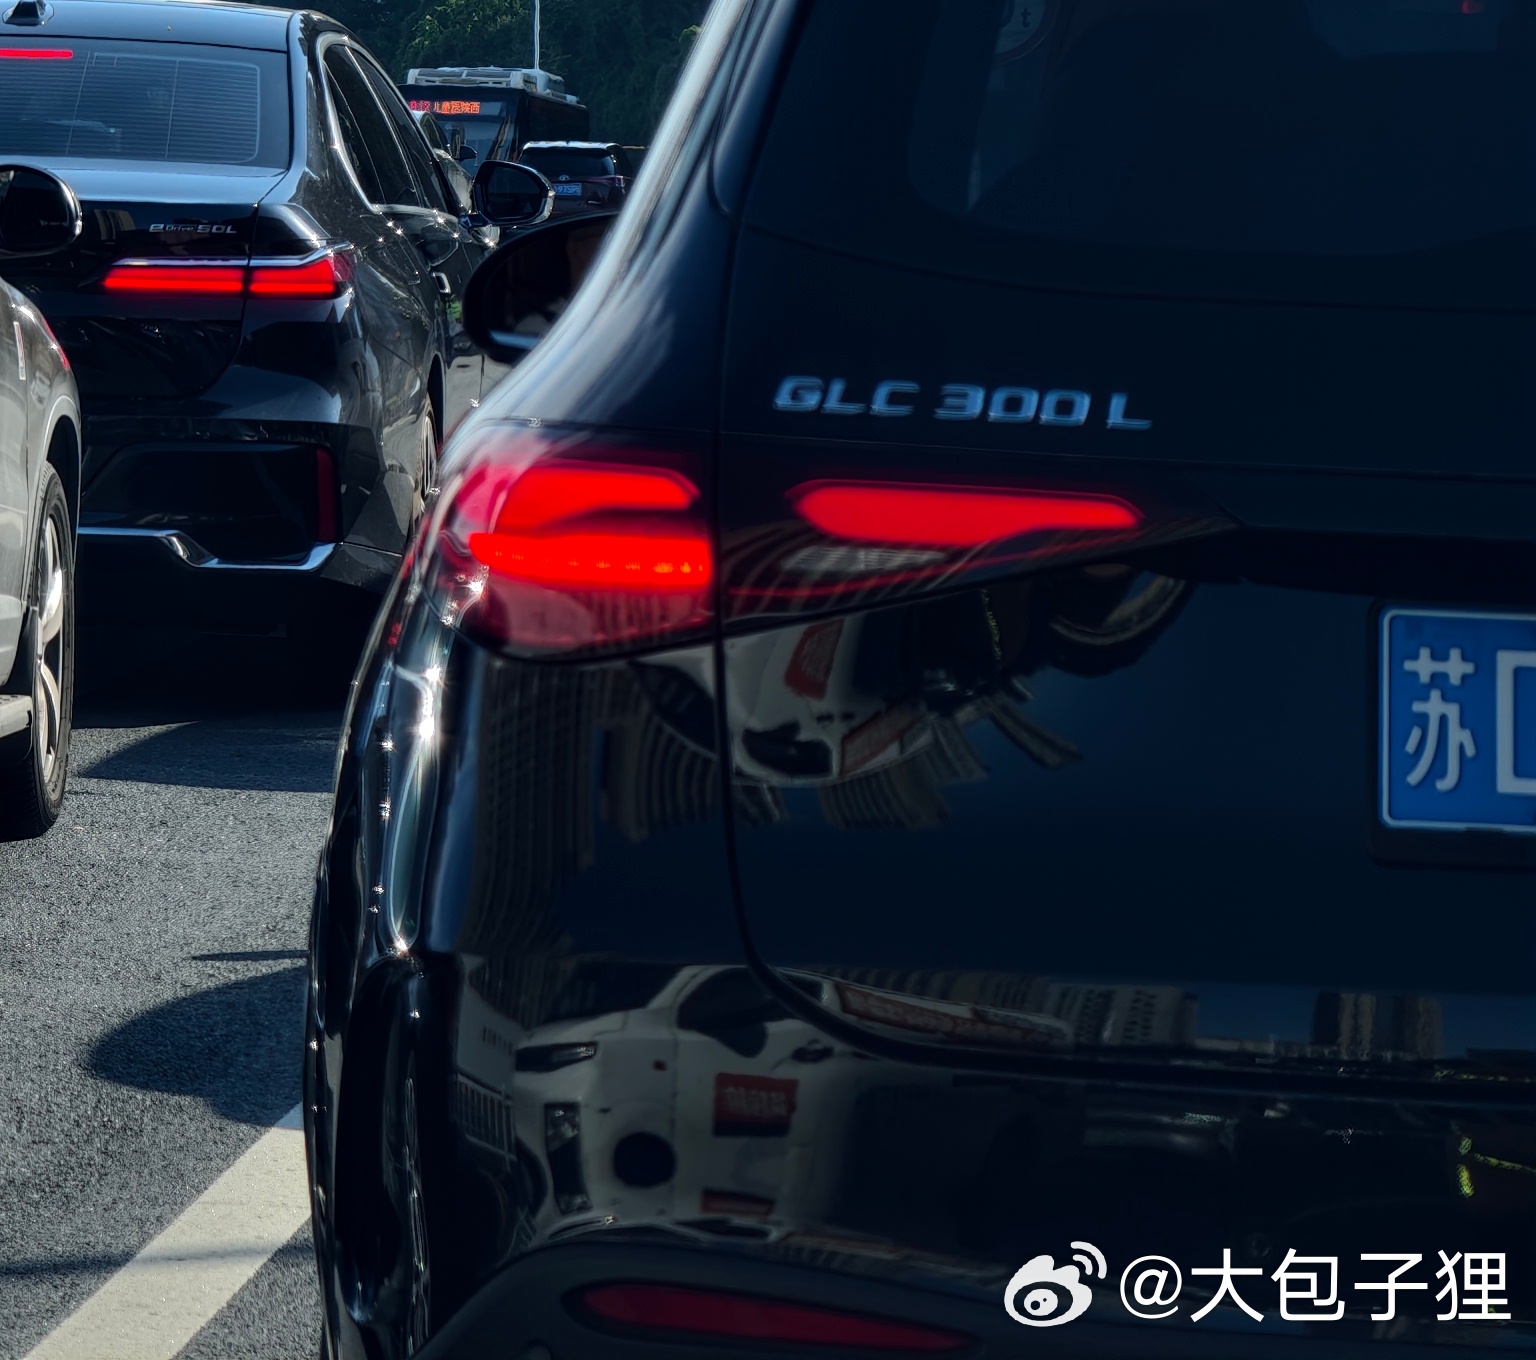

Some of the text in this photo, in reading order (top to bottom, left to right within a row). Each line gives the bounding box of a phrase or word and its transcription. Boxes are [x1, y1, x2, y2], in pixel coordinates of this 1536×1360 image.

[772, 374, 1153, 431] GLC 300 L
